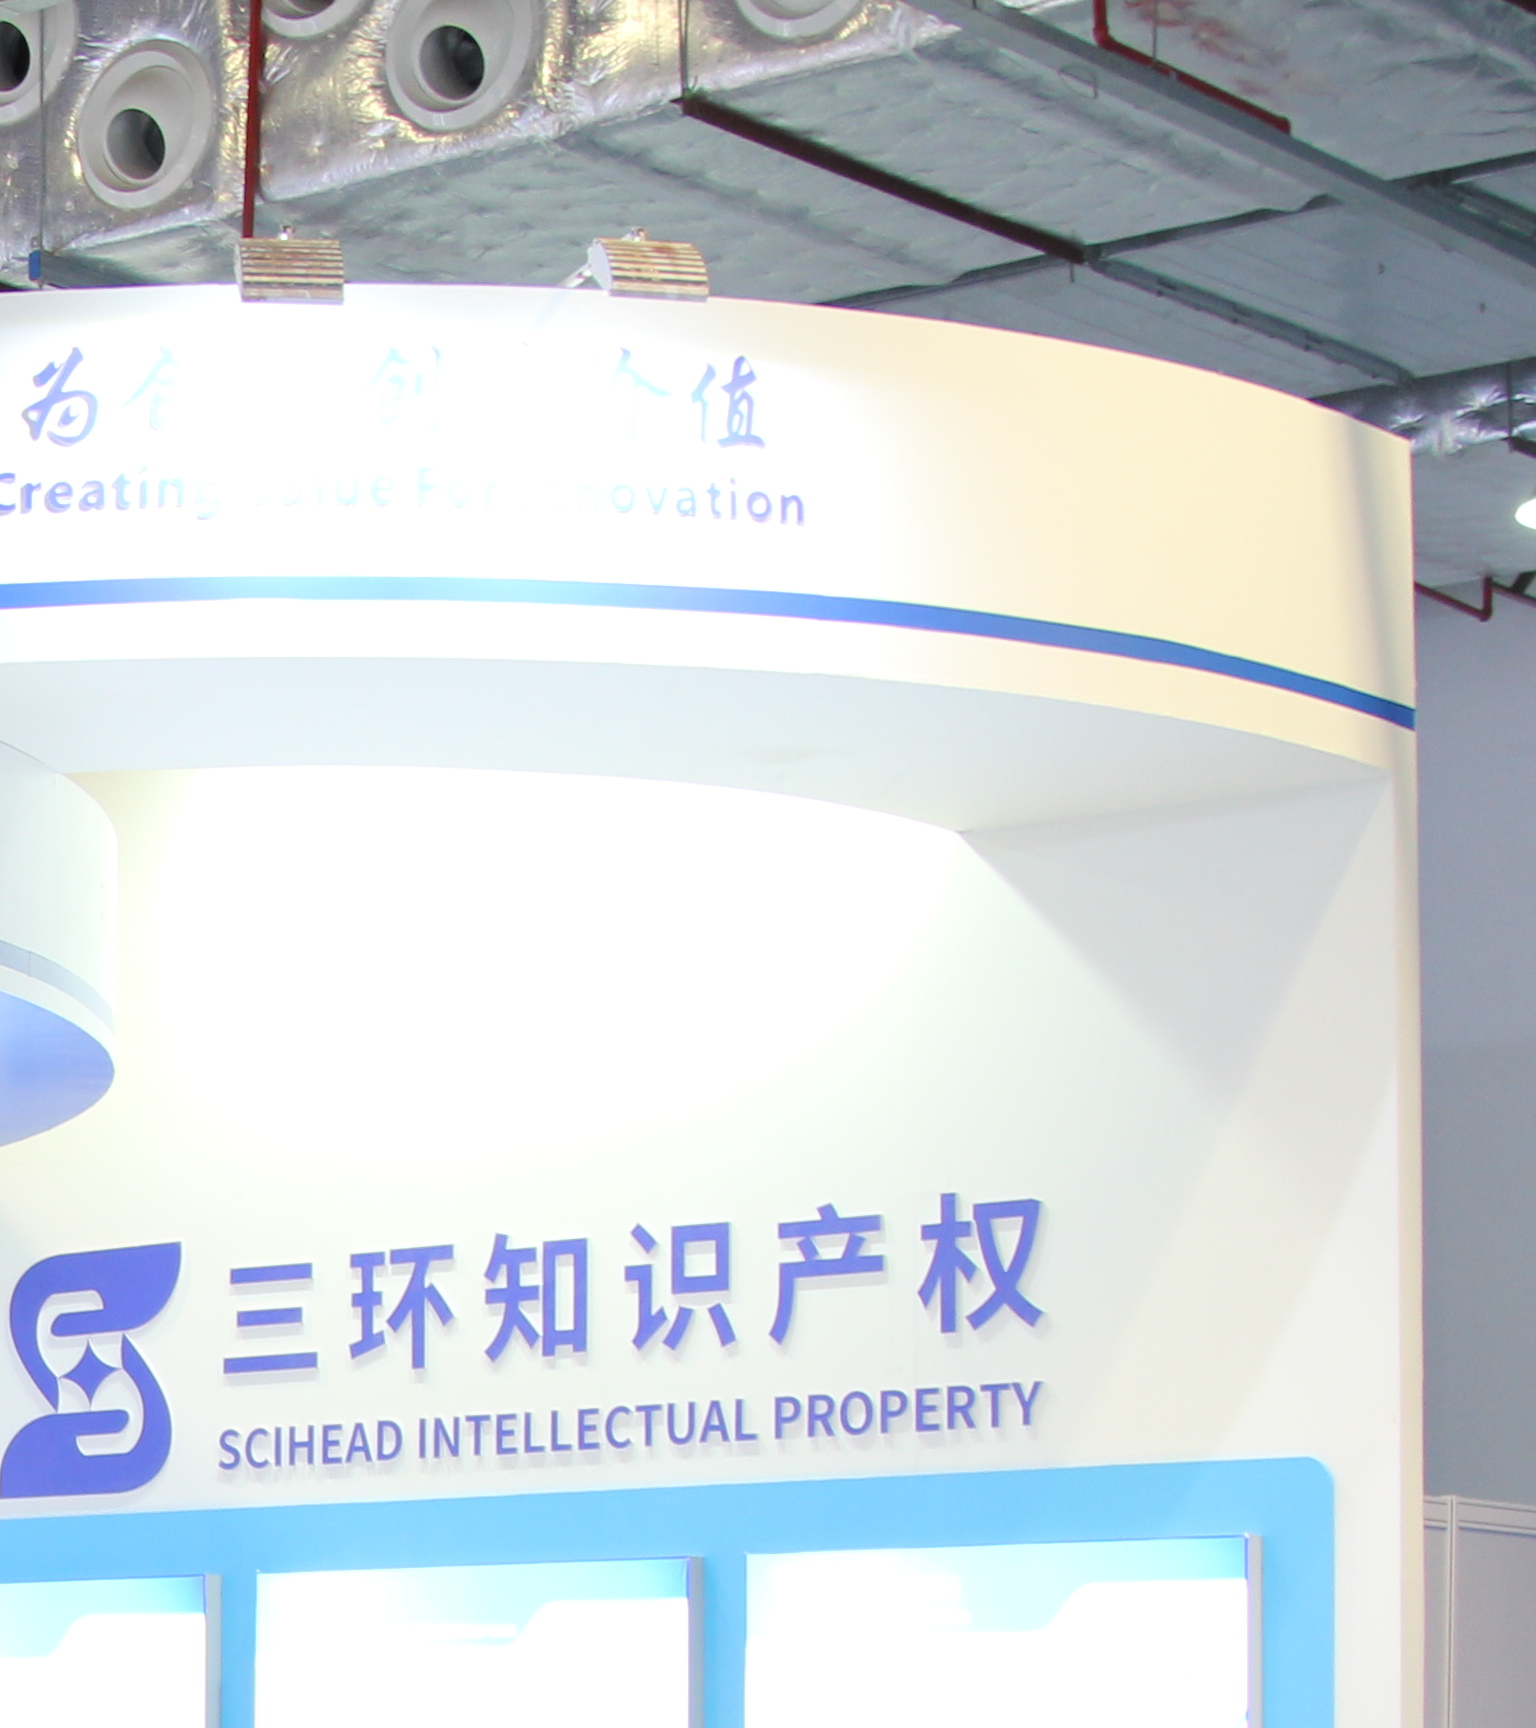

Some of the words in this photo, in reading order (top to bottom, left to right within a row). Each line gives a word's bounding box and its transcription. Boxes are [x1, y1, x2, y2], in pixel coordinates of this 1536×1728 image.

[222, 1191, 1048, 1376] 三环知识产权
[216, 1415, 404, 1473] SCIHEAD
[415, 1397, 759, 1464] INTELLECTUAL
[771, 1378, 1045, 1441] PROPERTY
